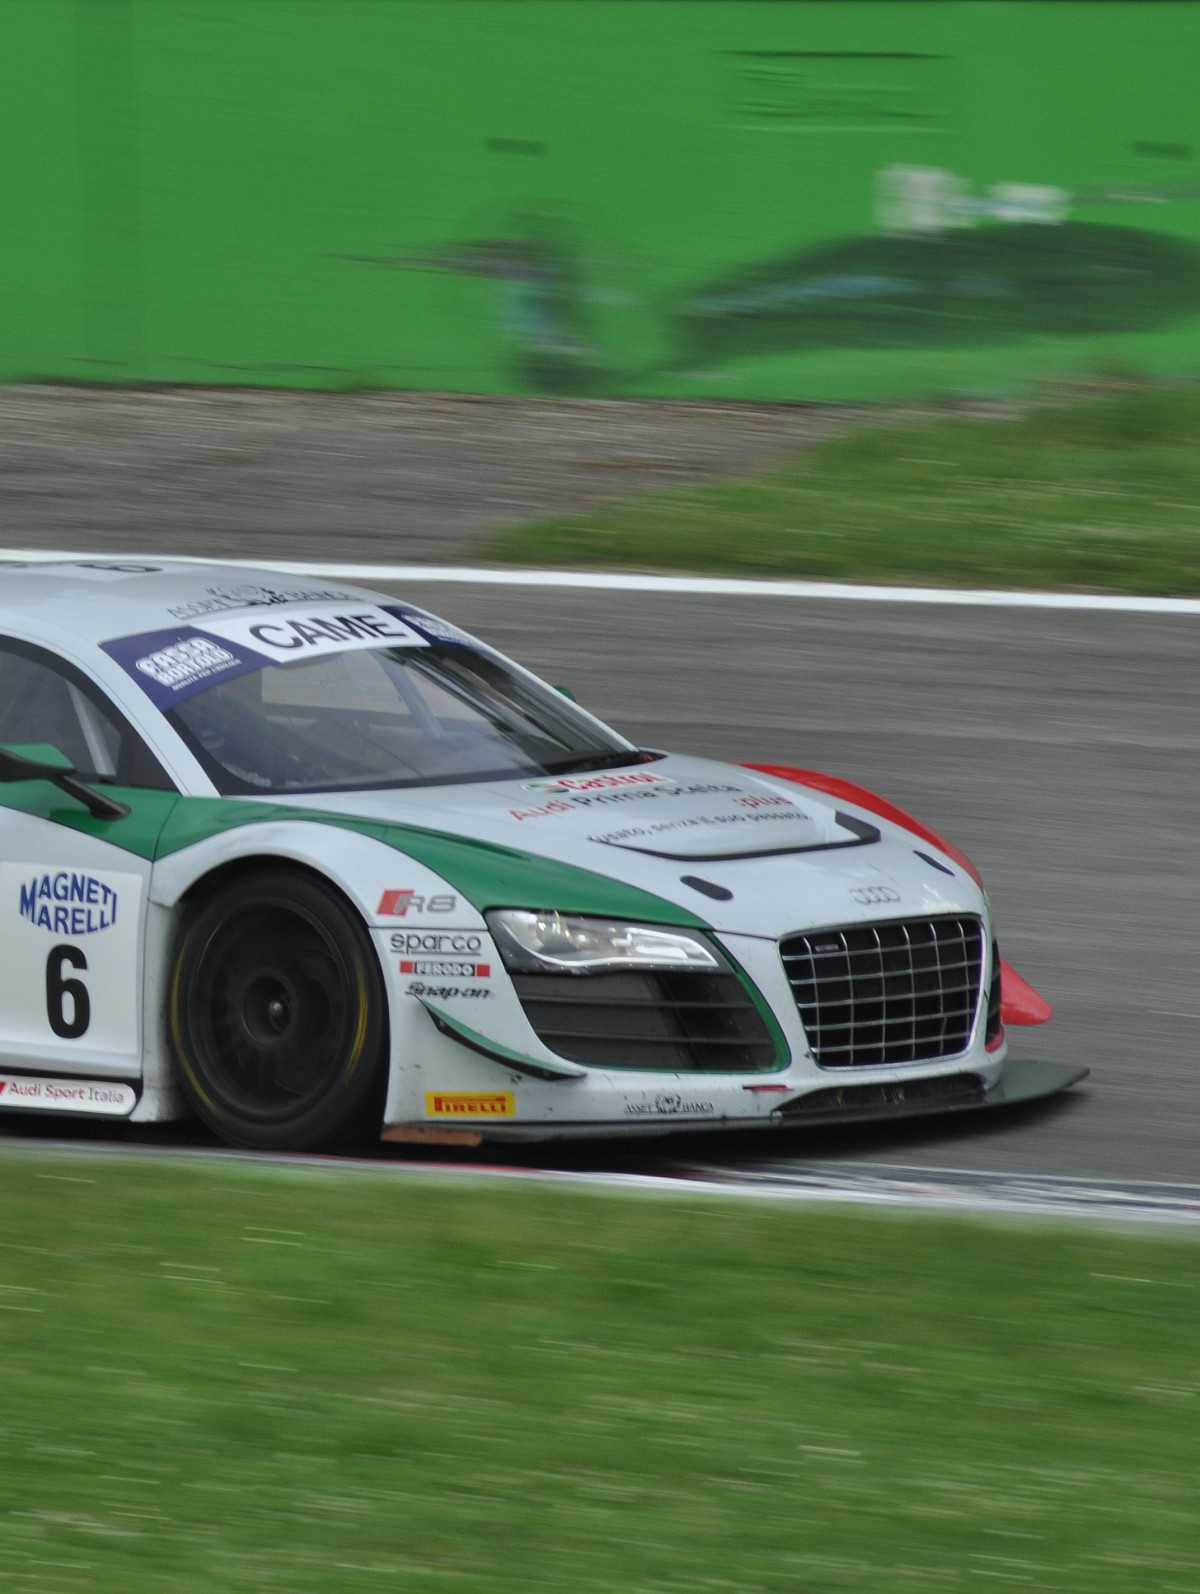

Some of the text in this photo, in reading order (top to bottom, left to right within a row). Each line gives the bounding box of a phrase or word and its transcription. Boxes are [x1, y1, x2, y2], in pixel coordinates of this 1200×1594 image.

[249, 613, 408, 649] CAME
[558, 772, 664, 791] Castrol
[509, 782, 744, 821] Audi Prima Scelta
[20, 872, 117, 918] MAGNETI
[392, 893, 457, 914] R8
[20, 892, 117, 935] MARELLI
[390, 933, 482, 954] sparco
[46, 944, 91, 1039] 6
[9, 1082, 125, 1103] Audi Sport Italia
[434, 1096, 506, 1112] PIRELLI
